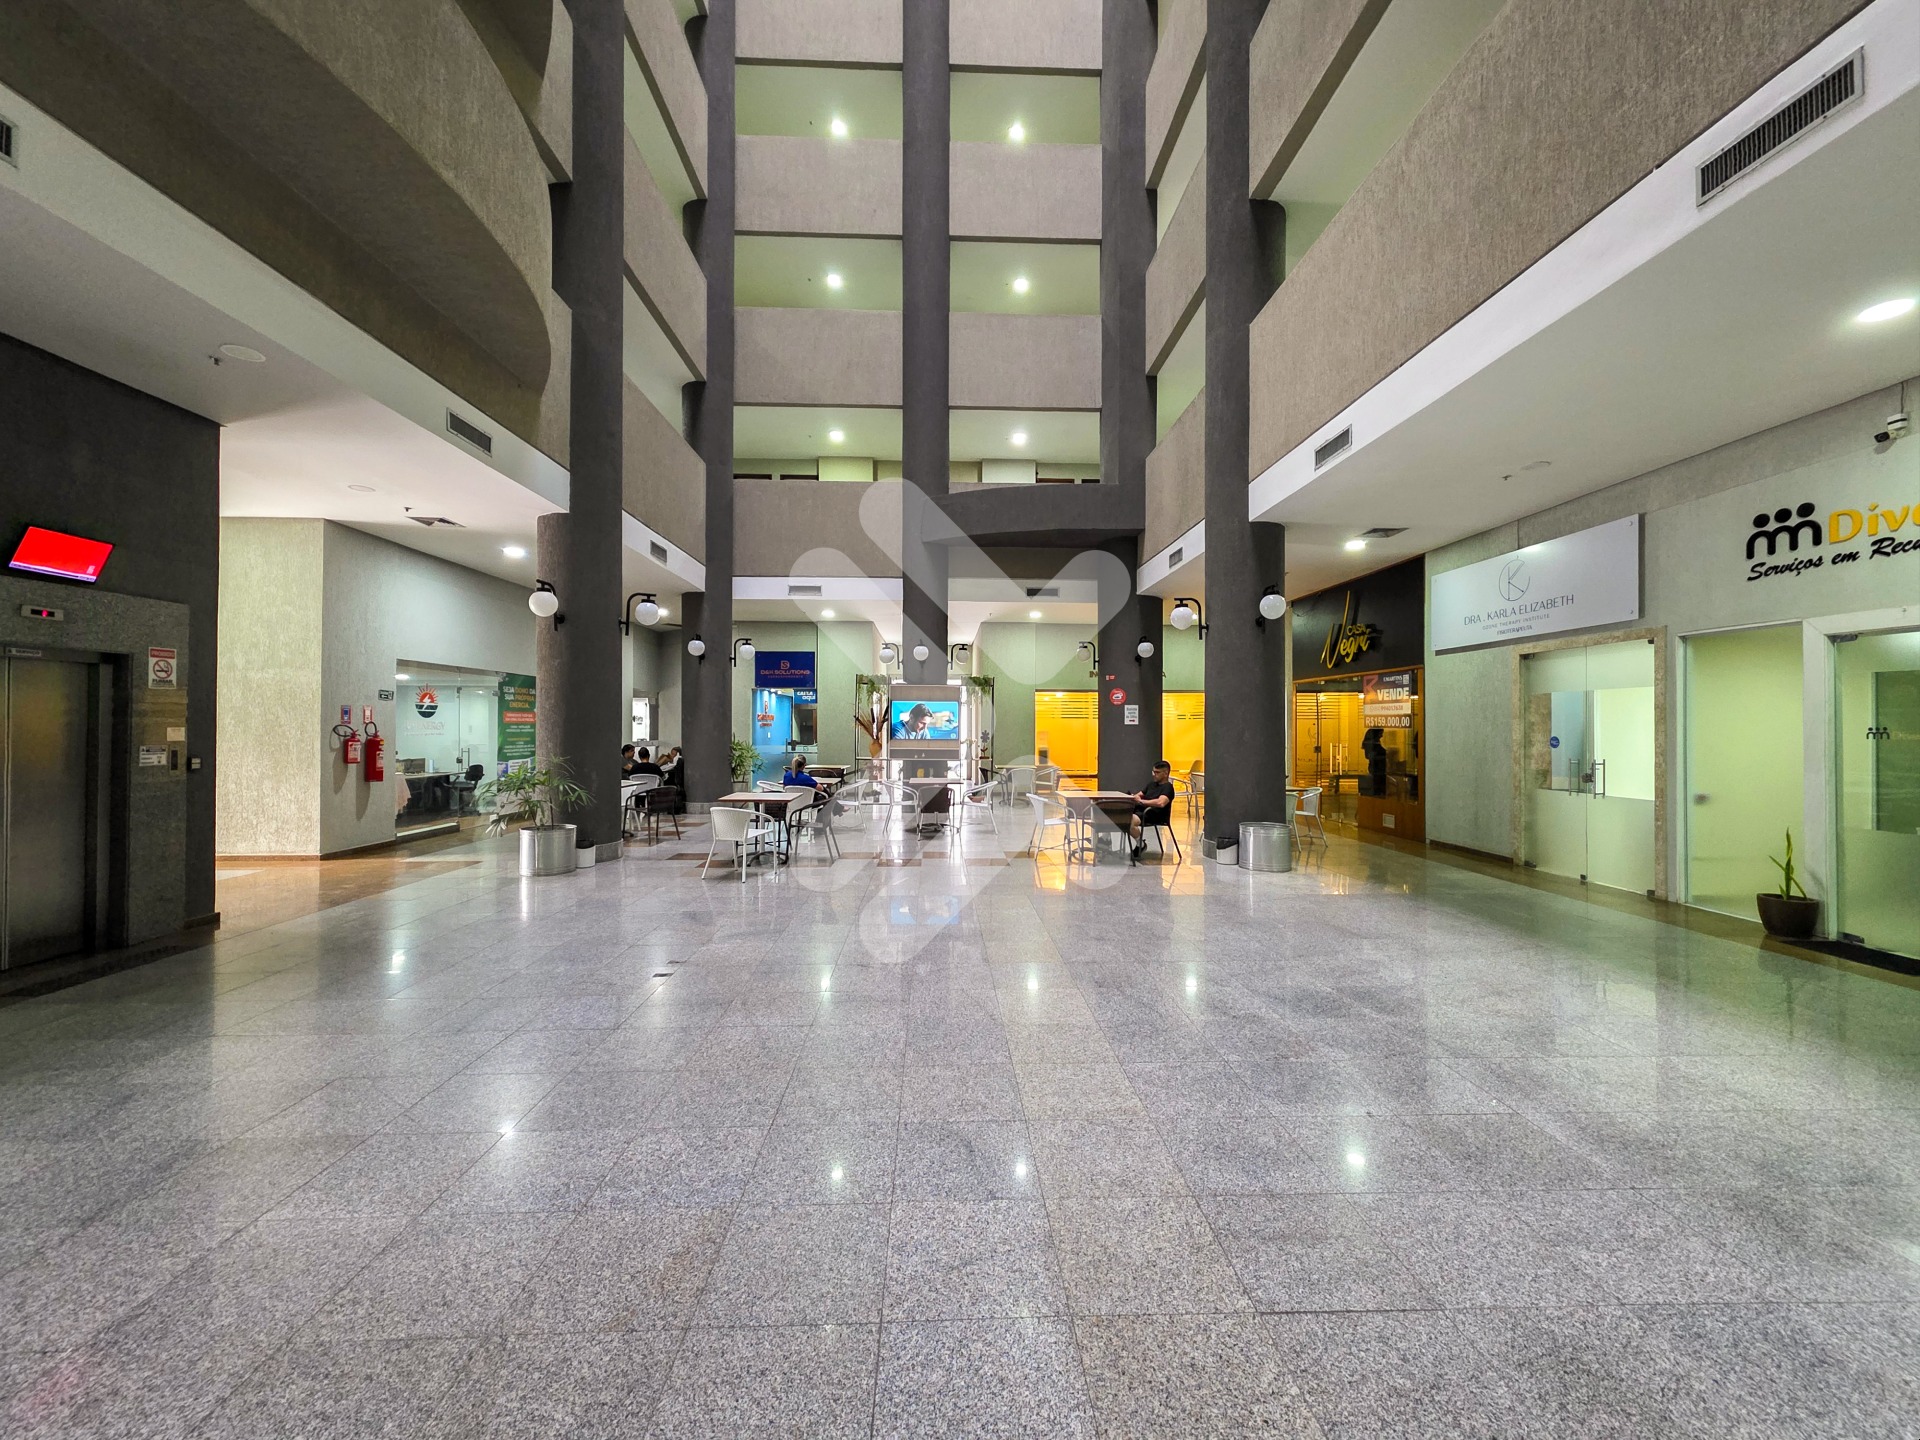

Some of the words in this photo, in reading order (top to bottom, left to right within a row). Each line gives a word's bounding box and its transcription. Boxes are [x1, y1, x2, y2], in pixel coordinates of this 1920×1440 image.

[1747, 555, 1824, 581] Serviços
[1831, 550, 1860, 566] em
[1487, 606, 1517, 621] KARLA
[1518, 594, 1574, 615] ELIZABETH
[1499, 618, 1521, 627] THERAPY
[1522, 613, 1551, 623] INSTITUTE
[1320, 590, 1371, 669] Negri
[1346, 623, 1366, 636] CASA
[1377, 687, 1410, 701] VENDE
[1365, 716, 1410, 728] R$159.000,00
